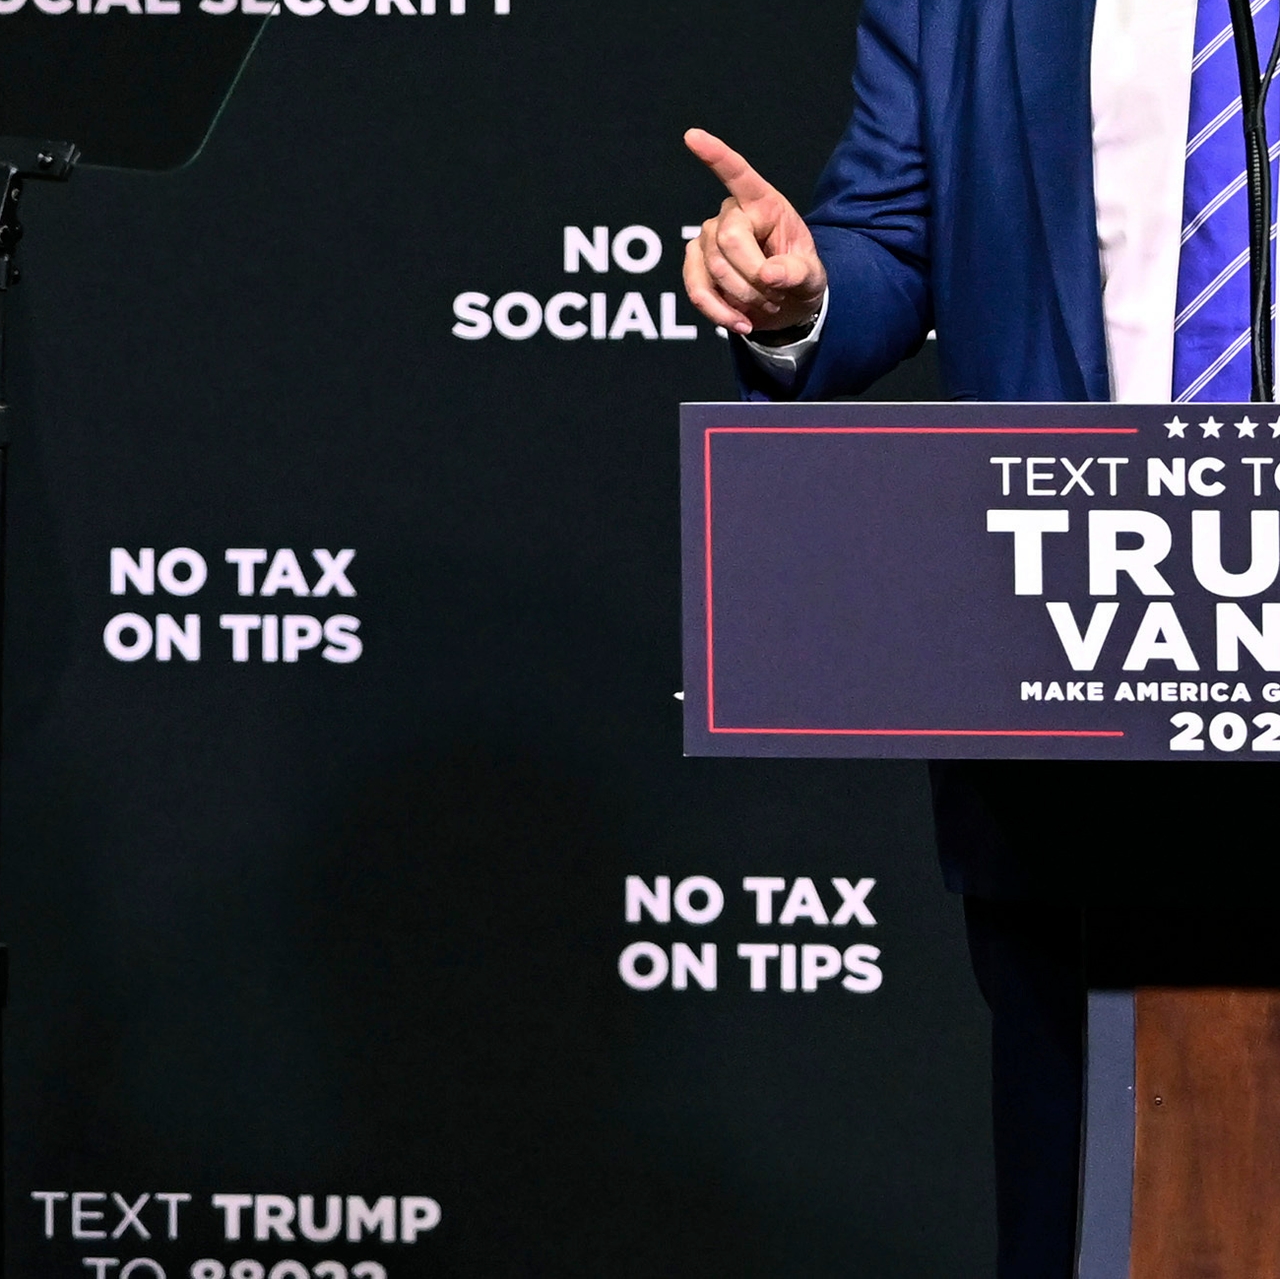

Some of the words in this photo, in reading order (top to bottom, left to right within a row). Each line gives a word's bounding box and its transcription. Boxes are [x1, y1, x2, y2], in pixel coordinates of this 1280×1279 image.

[562, 223, 664, 275] NO
[450, 289, 698, 342] SOCIAL
[988, 455, 1131, 498] TEXT
[1145, 455, 1228, 499] NC
[109, 546, 209, 598] NO
[223, 547, 358, 598] TAX
[102, 611, 202, 663] ON
[218, 612, 364, 665] TIPS
[1019, 680, 1105, 703] MAKE
[1113, 680, 1252, 704] AMERICA
[624, 874, 726, 926] NO
[741, 875, 879, 927] TAX
[617, 940, 719, 993] ON
[735, 942, 884, 995] TIPS
[30, 1190, 193, 1240] TEXT
[211, 1192, 442, 1244] TRUMP
